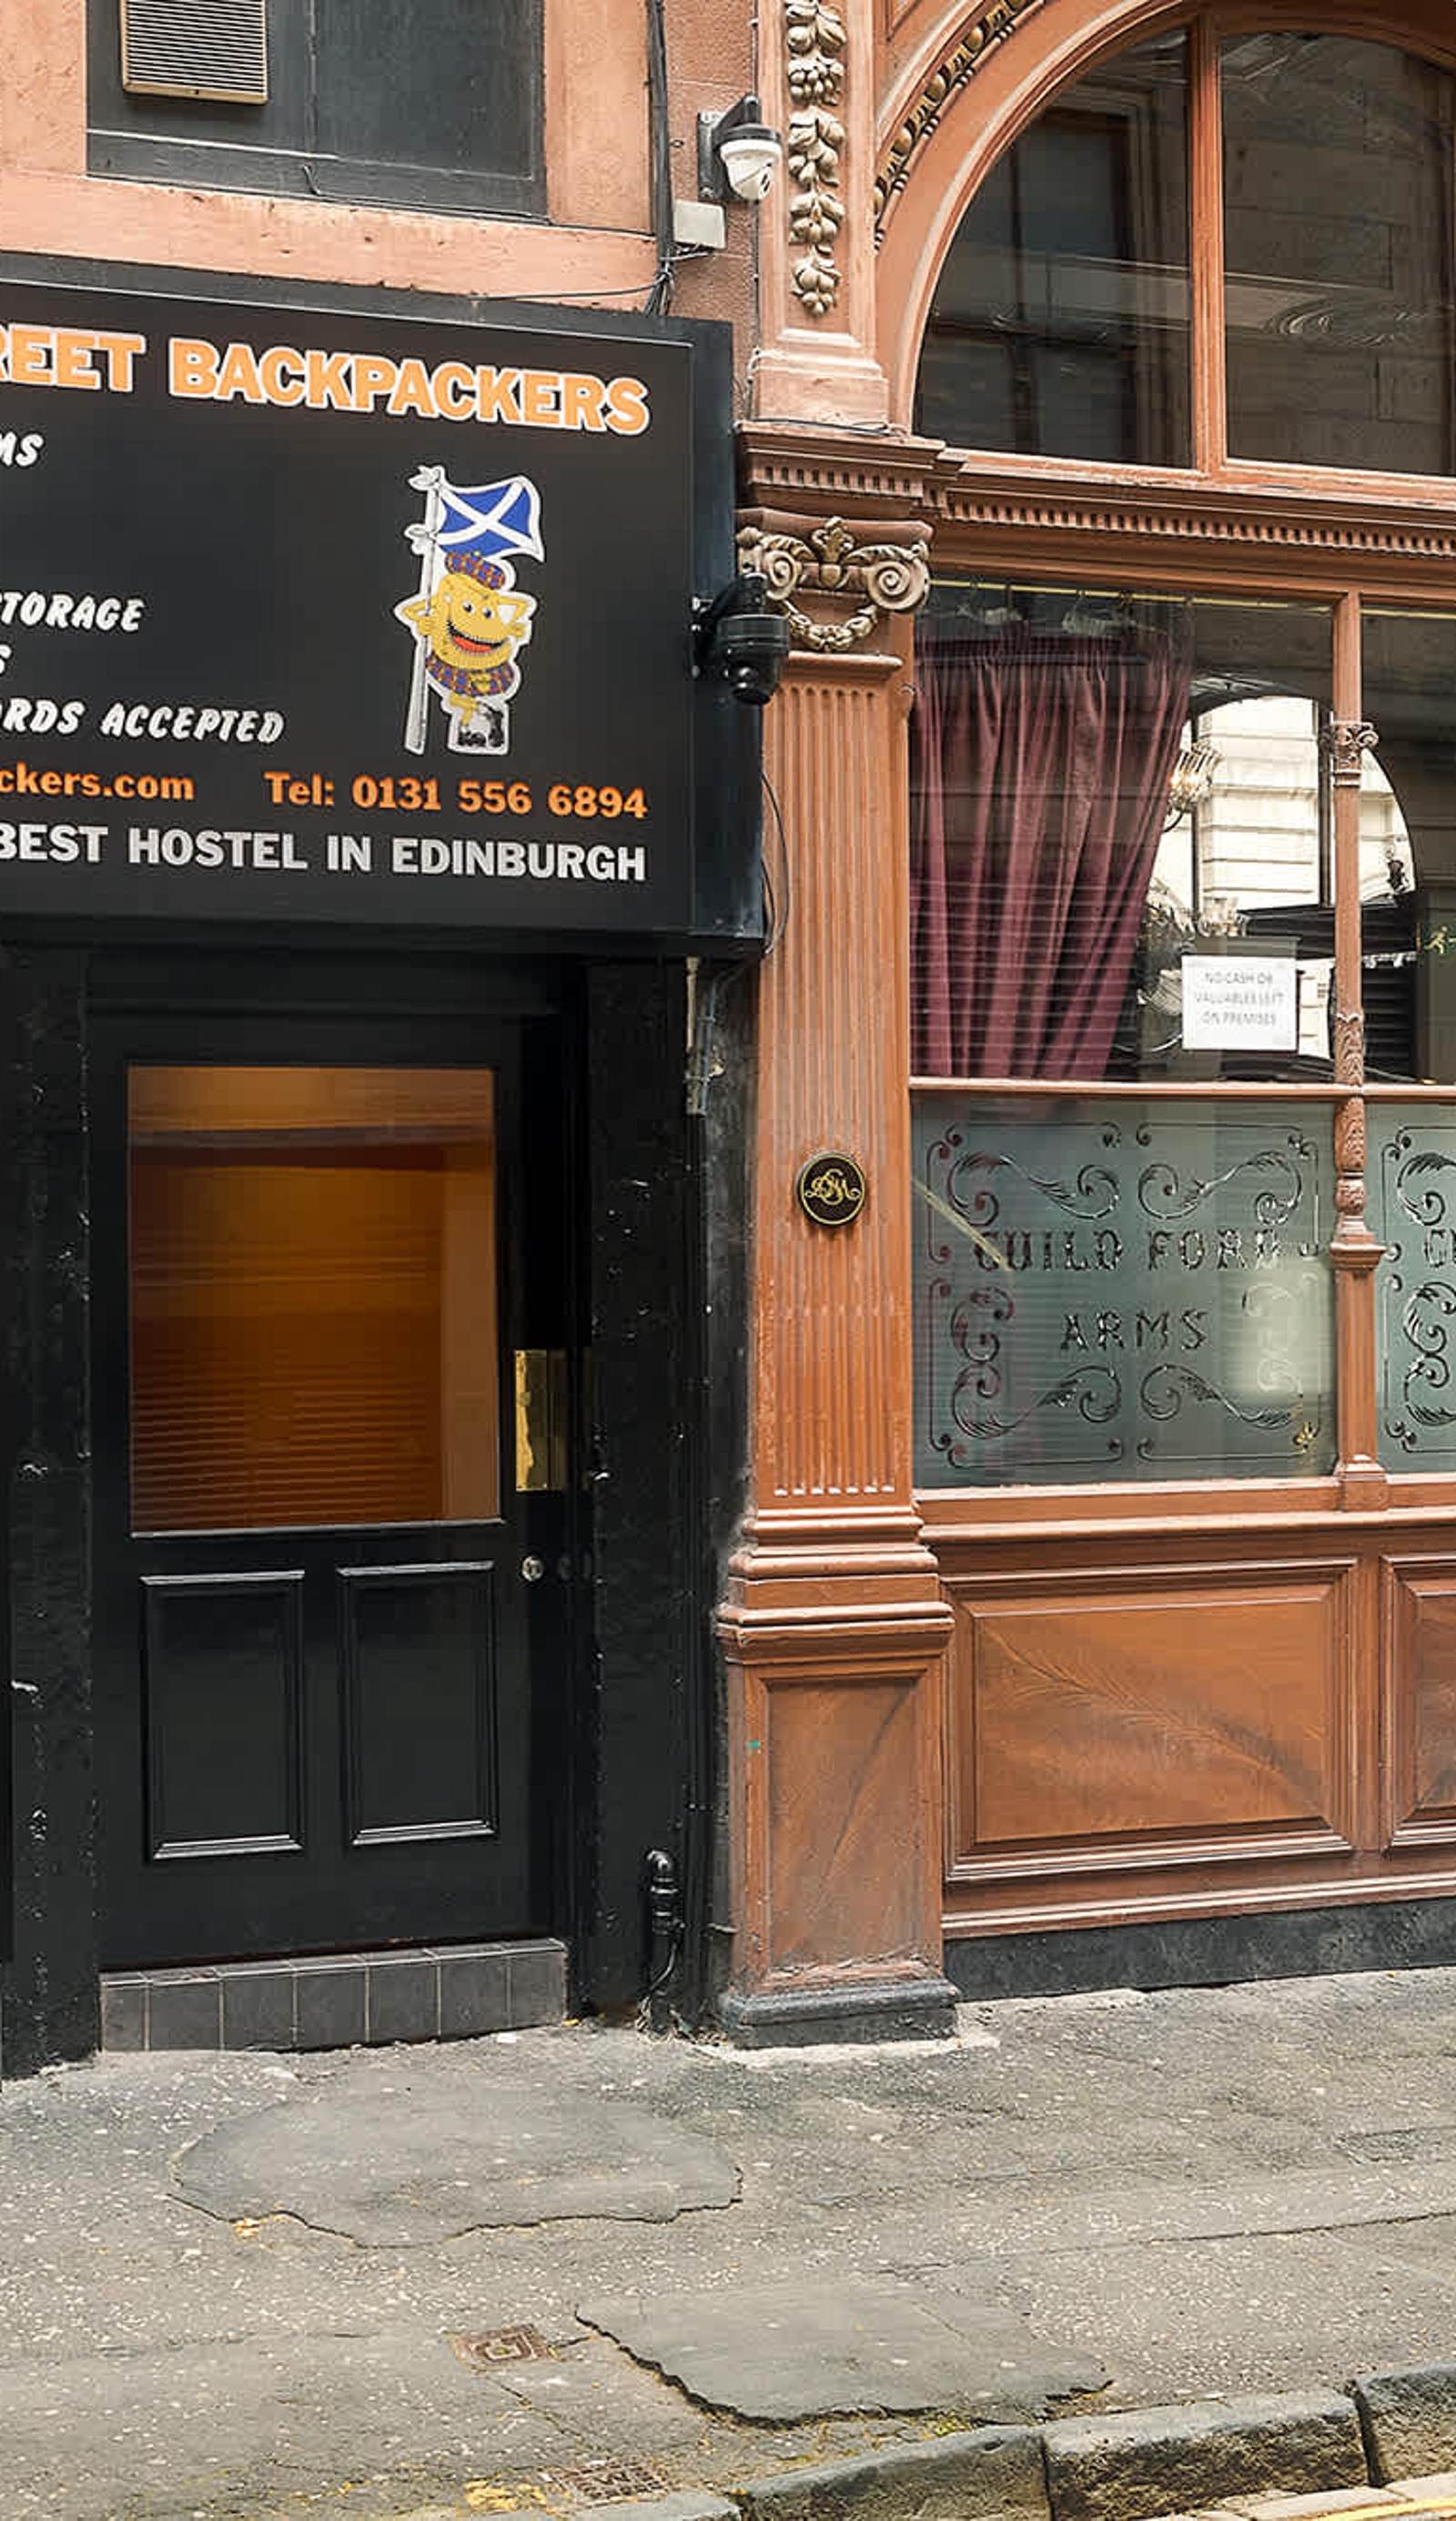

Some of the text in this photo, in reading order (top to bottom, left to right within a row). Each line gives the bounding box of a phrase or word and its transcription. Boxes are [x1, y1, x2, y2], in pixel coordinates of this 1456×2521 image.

[0, 323, 649, 436] EET BACKPACKERS
[0, 592, 146, 631] TORAGE
[0, 697, 284, 744] RDS ACCEPTED
[0, 762, 648, 819] ckers.com Tel: 0131 556 6894
[128, 828, 308, 869] HOSTEL
[328, 835, 371, 872] IN
[392, 838, 645, 881] EDINBURGH
[1059, 1307, 1209, 1352] ARMS
